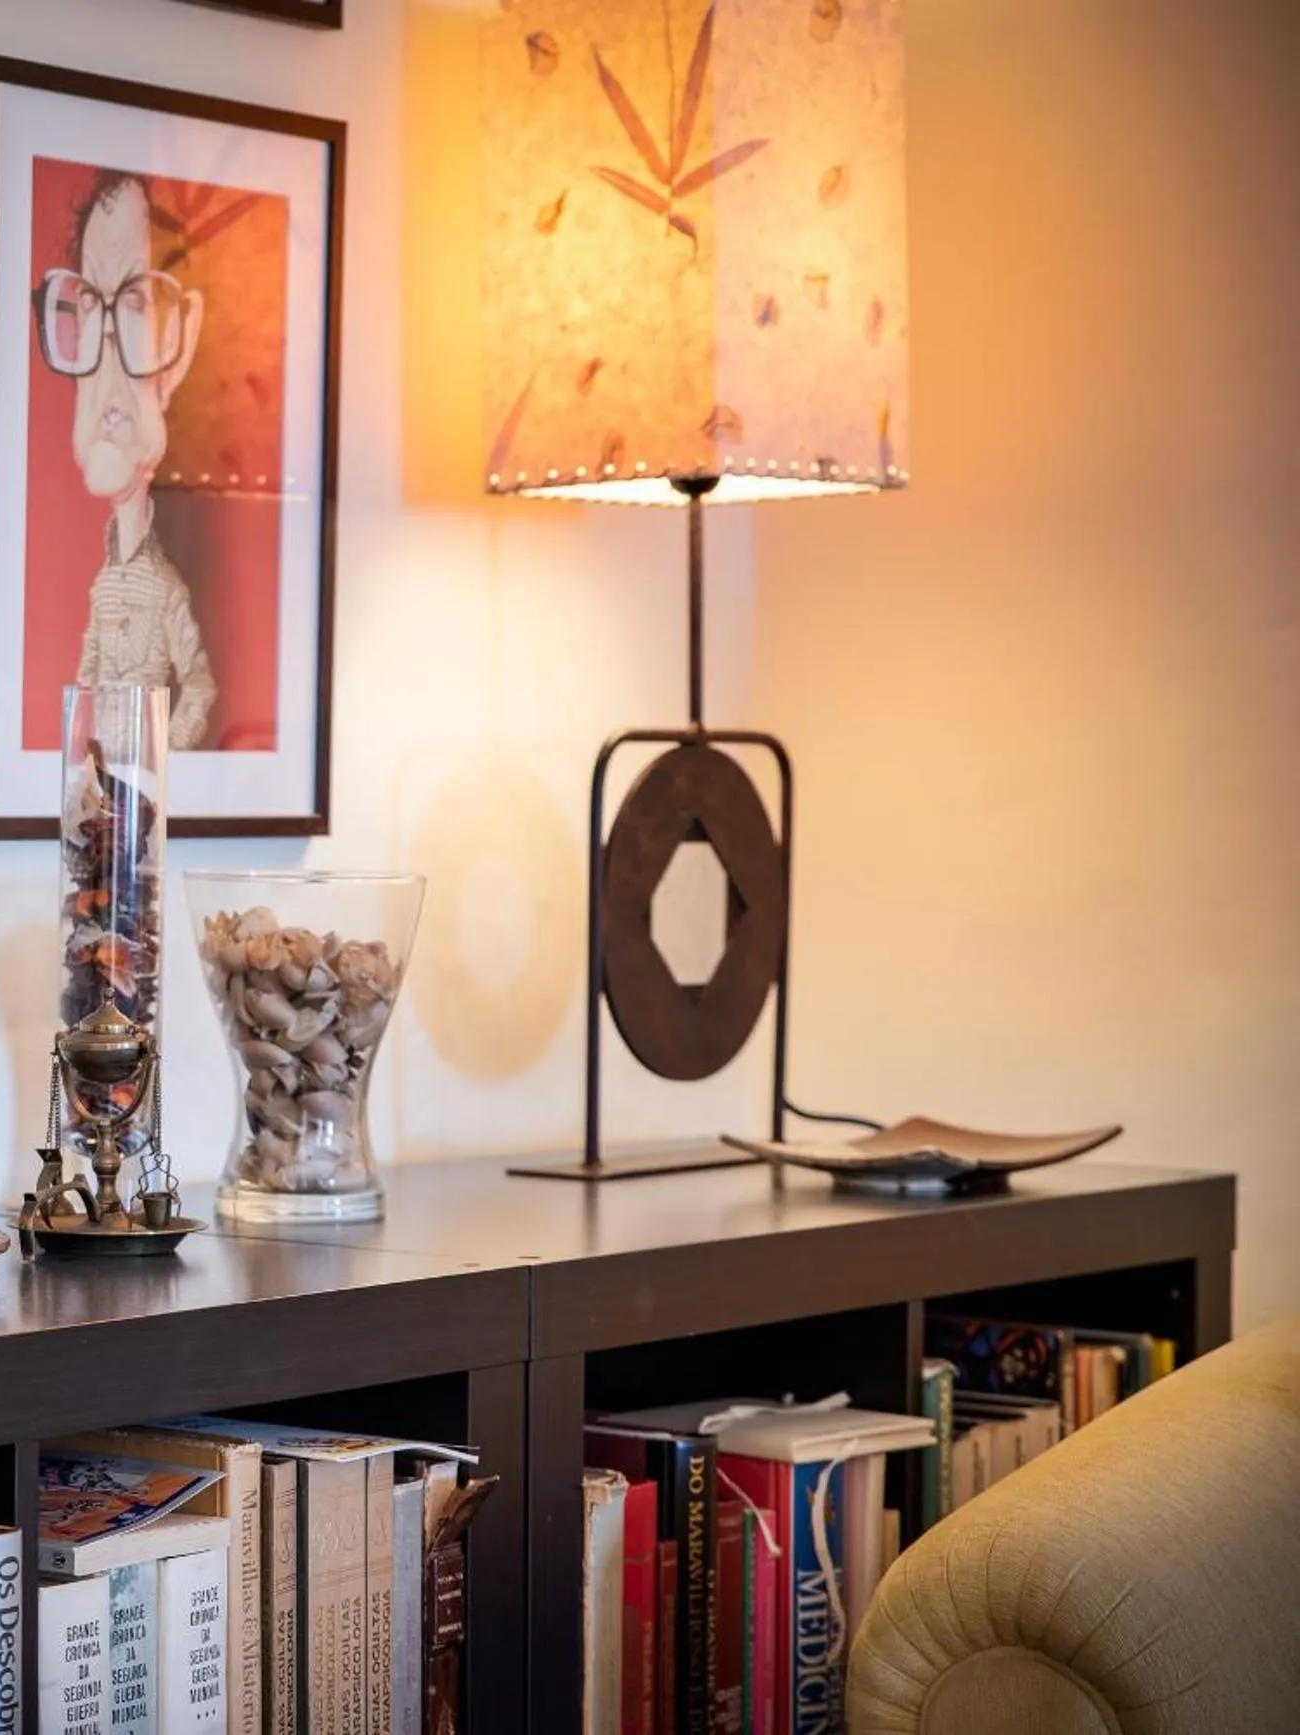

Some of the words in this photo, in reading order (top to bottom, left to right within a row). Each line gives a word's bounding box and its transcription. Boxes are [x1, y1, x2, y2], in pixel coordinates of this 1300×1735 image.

[687, 1456, 705, 1495] DO
[241, 1487, 259, 1614] Maravilhas
[66, 1620, 100, 1642] GRANDE
[341, 1598, 351, 1681] OCULTAS
[371, 1591, 381, 1674] OCULTAS
[79, 1664, 89, 1680] DA
[112, 1663, 148, 1685] SEGUNDA
[63, 1680, 102, 1702] SEGUNDA
[114, 1682, 146, 1704] GUERRA
[67, 1701, 100, 1722] GUERRA
[112, 1702, 148, 1725] MUNDIAL
